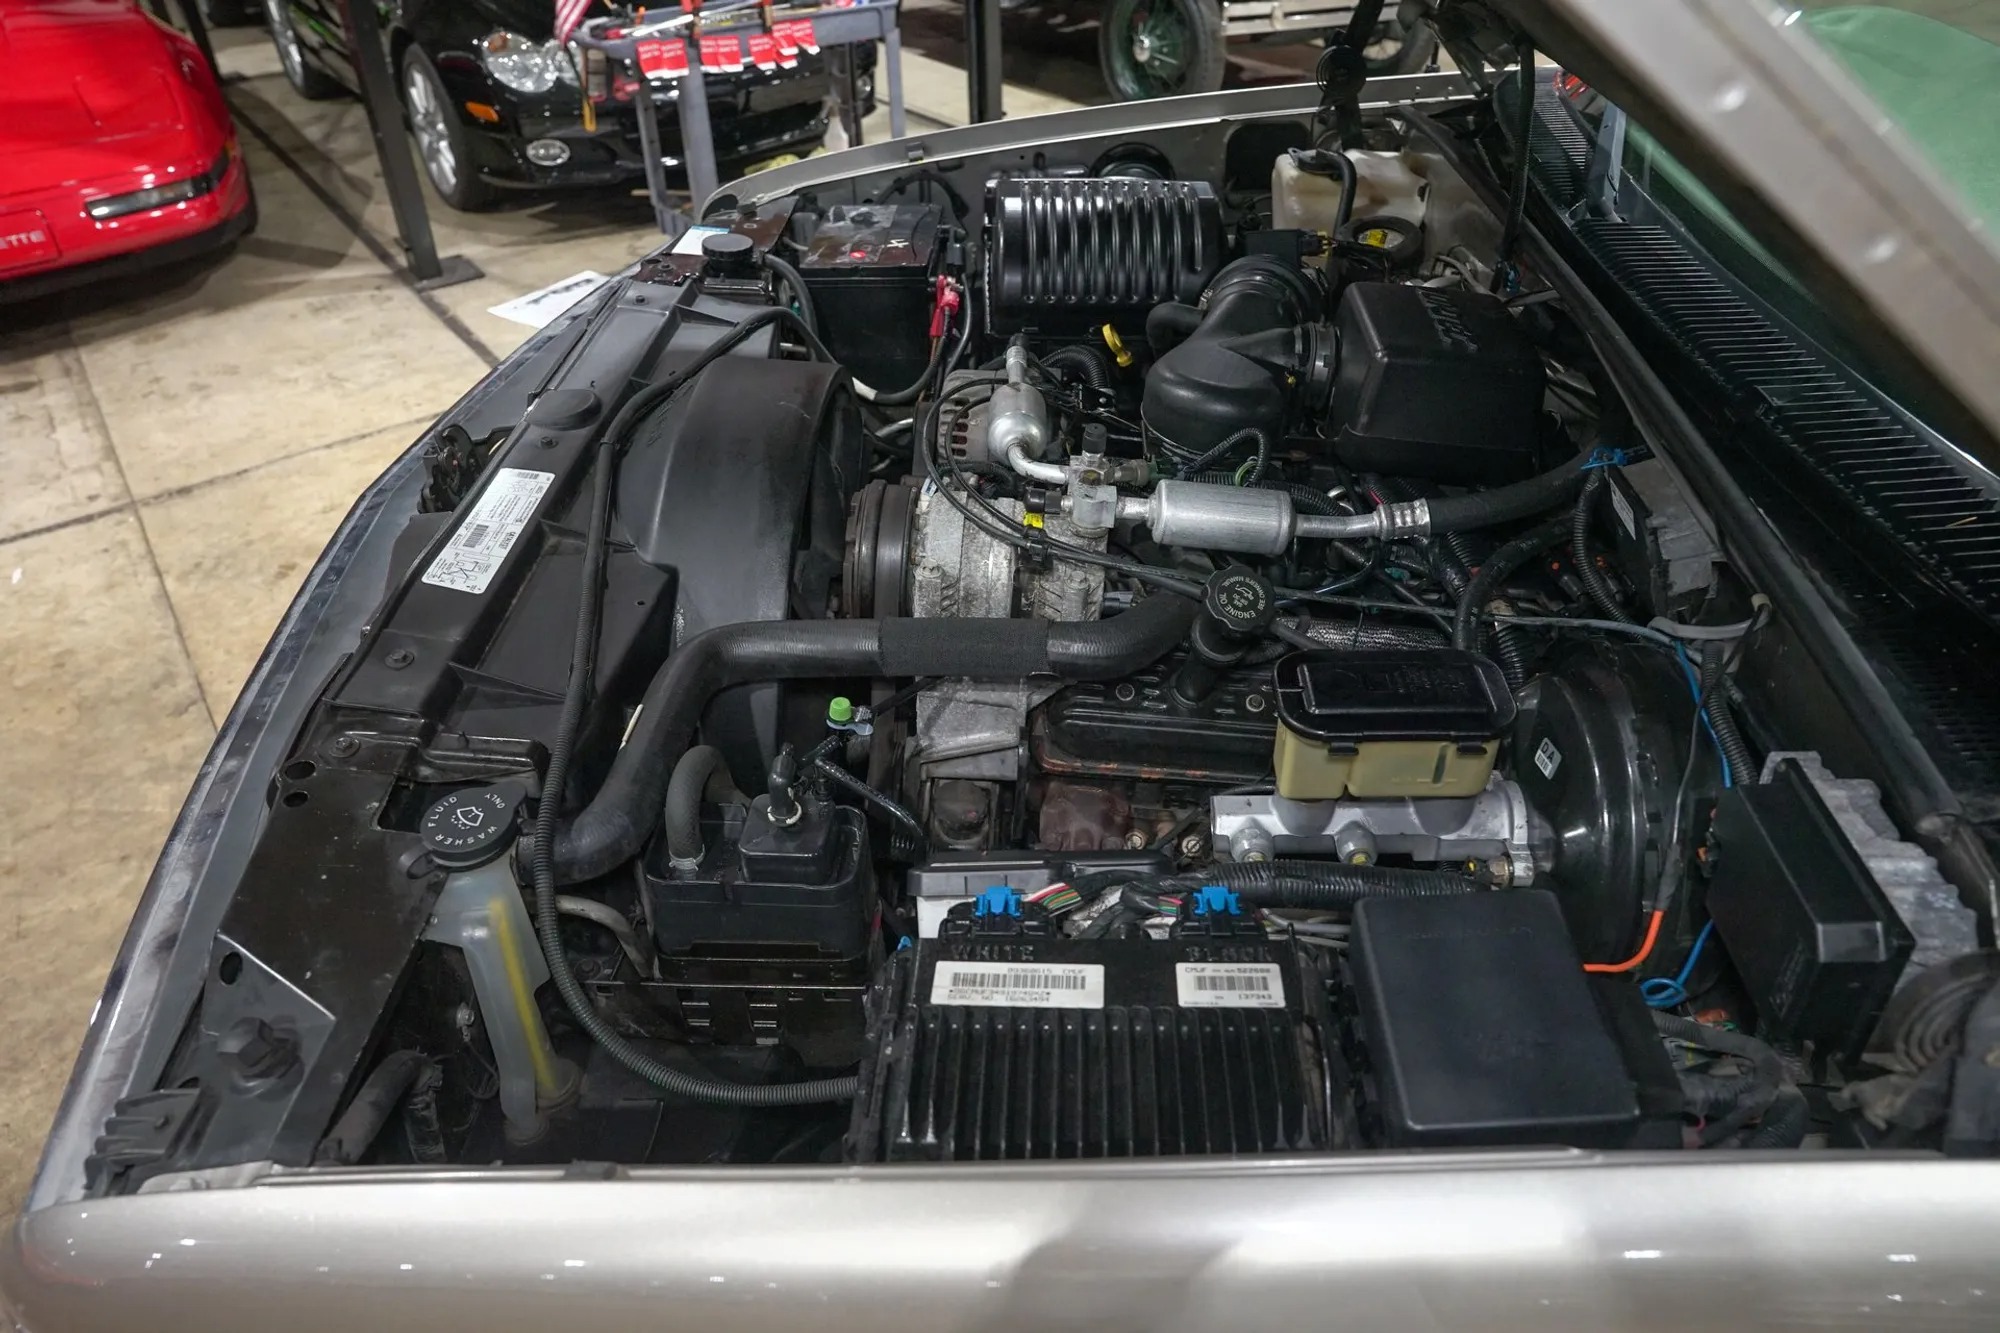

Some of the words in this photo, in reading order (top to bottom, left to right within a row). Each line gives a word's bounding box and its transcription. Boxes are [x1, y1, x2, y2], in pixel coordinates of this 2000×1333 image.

[1221, 576, 1244, 587] MANUAL
[1219, 592, 1228, 605] OIL
[1224, 604, 1256, 619] ENGINE
[484, 793, 505, 809] ONLY
[428, 796, 457, 827] FLUID
[435, 826, 497, 846] WASHER
[952, 944, 1034, 960] WHITE
